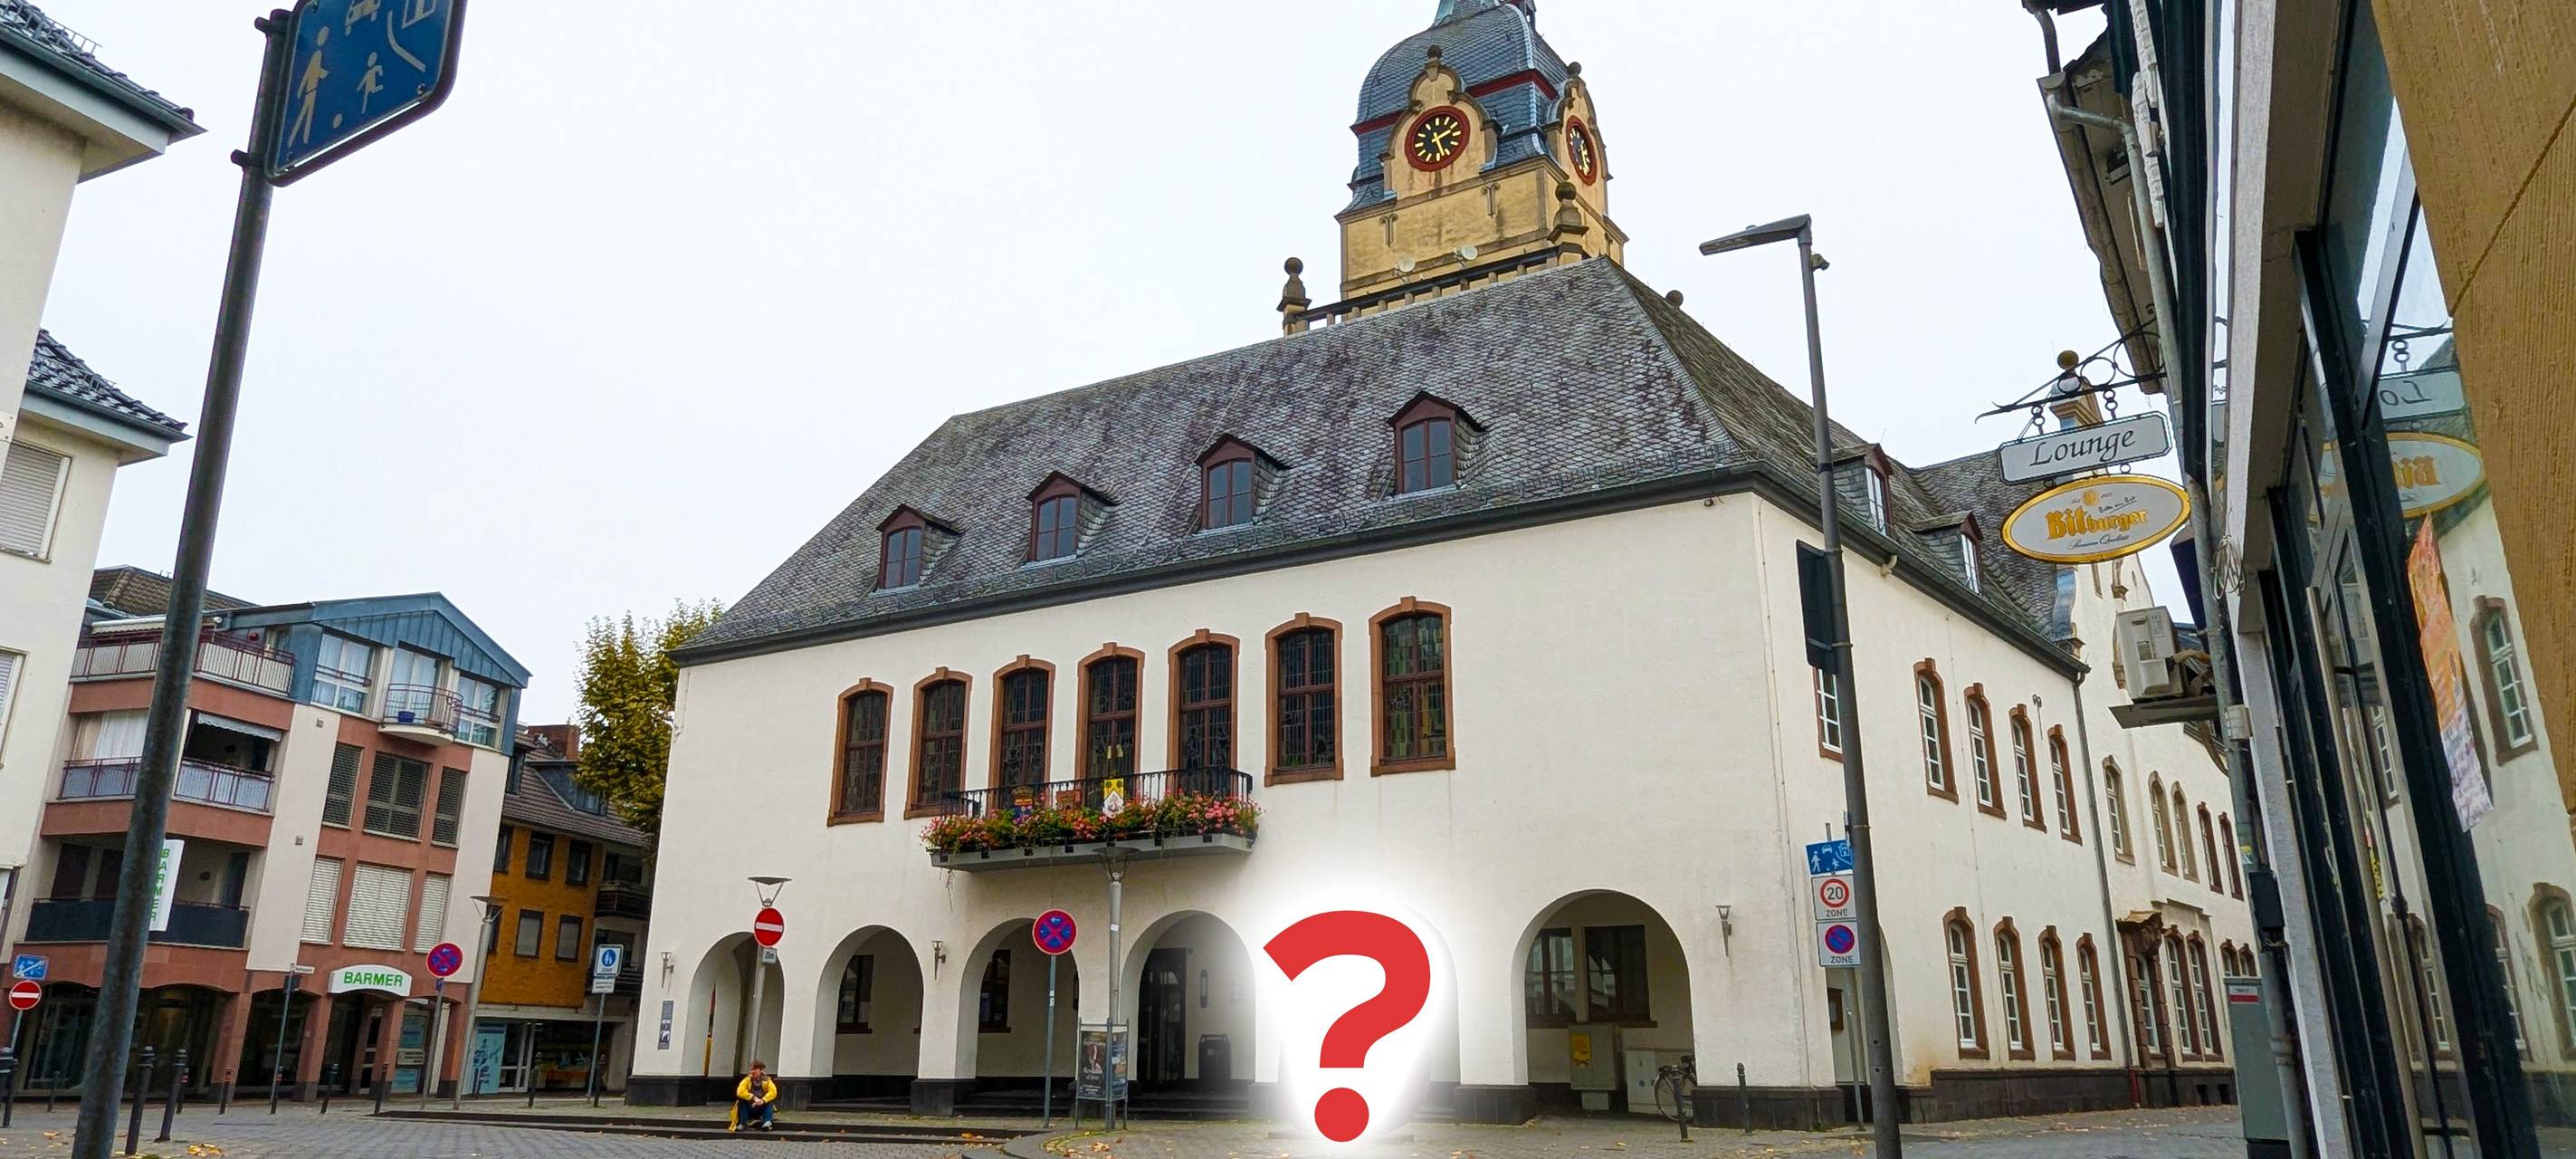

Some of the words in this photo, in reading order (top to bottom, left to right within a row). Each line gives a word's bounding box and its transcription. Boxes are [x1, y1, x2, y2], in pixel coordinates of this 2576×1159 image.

[2029, 429, 2136, 466] Lounge
[2045, 505, 2149, 541] Bitburger
[1827, 886, 1844, 900] 20
[1826, 908, 1848, 917] ZONE
[1830, 955, 1854, 964] ZONE
[343, 971, 404, 987] BARMER
